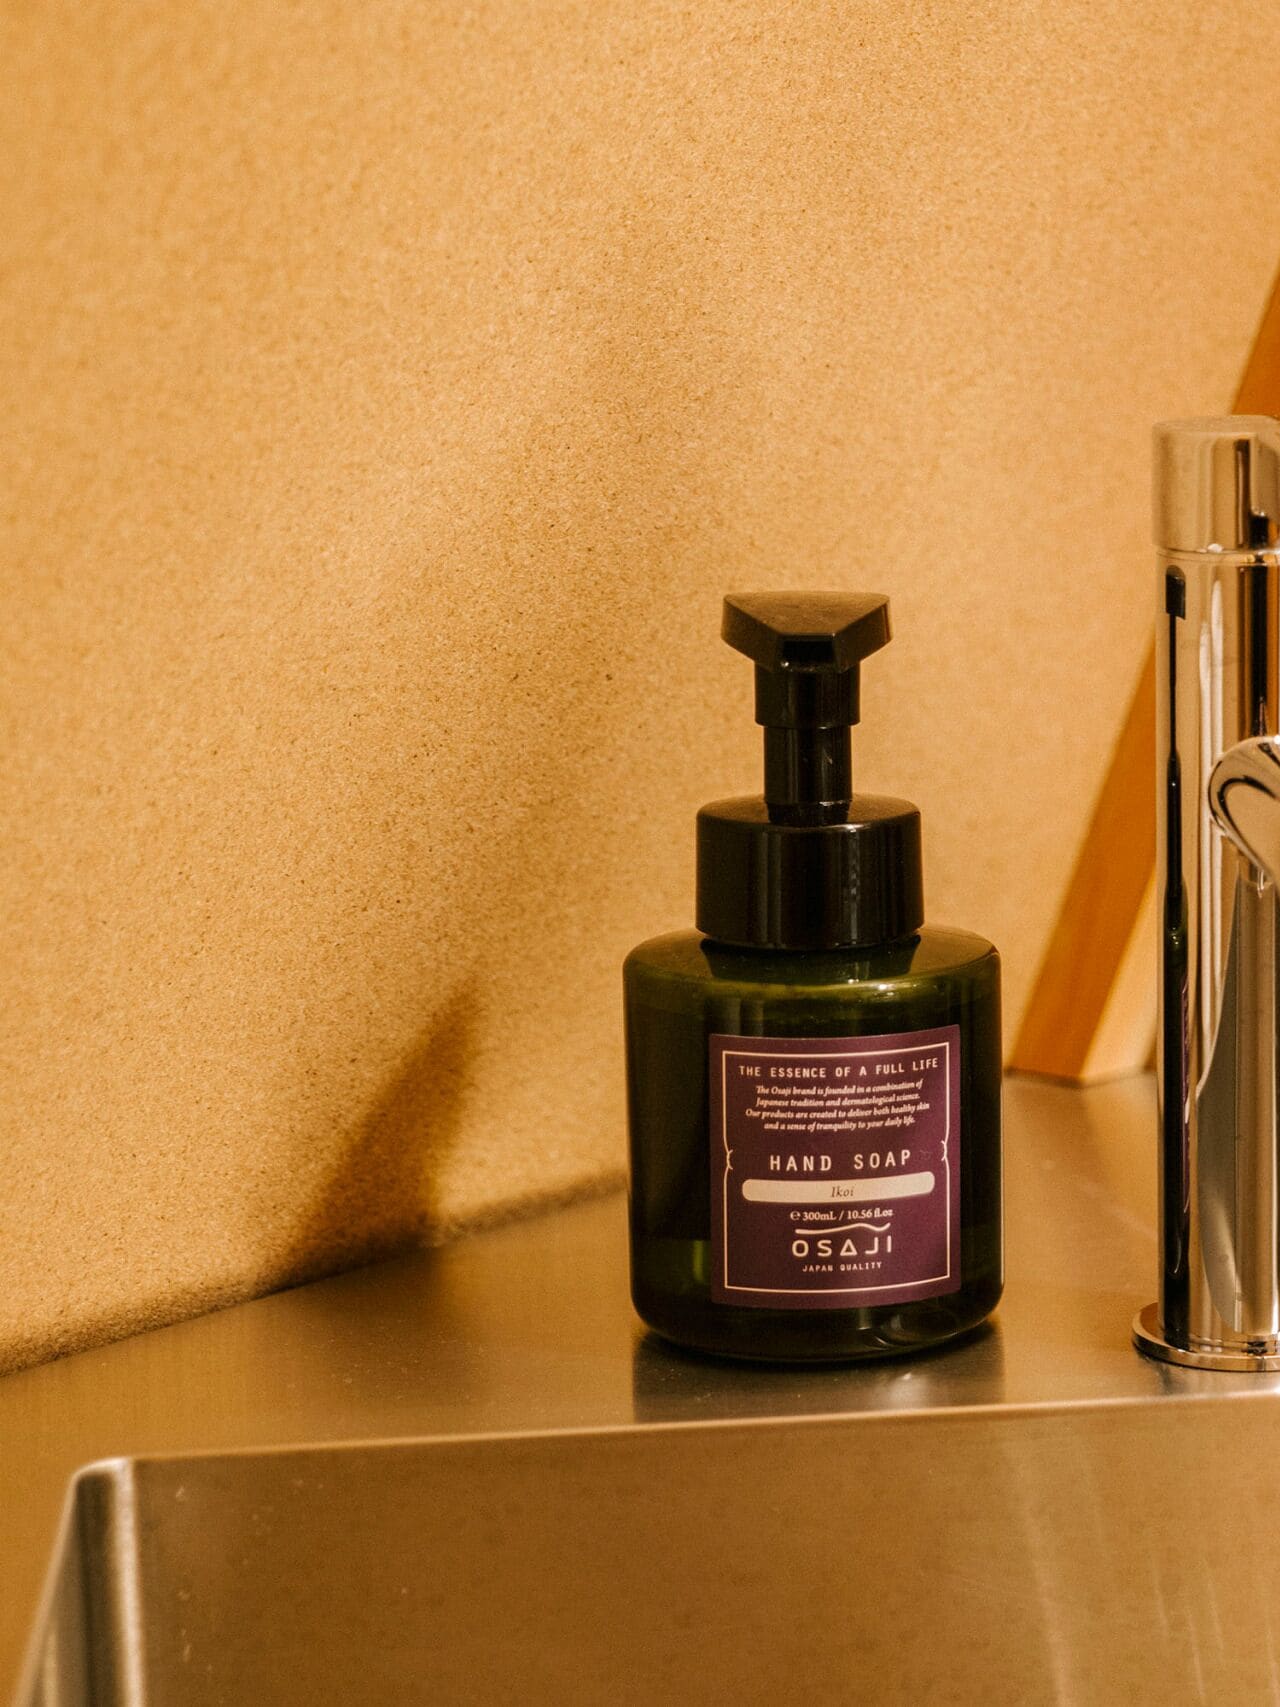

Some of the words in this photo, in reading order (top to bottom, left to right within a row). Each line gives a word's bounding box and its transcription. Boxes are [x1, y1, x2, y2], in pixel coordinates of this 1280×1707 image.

[739, 1065, 761, 1077] THE
[770, 1067, 826, 1078] ESSENCE
[835, 1066, 851, 1077] OF
[859, 1066, 867, 1076] A
[875, 1063, 905, 1075] FULL
[912, 1057, 938, 1071] LIFE
[755, 1085, 769, 1094] The
[771, 1086, 791, 1096] Osaji
[793, 1086, 816, 1095] brand
[817, 1087, 823, 1095] is
[823, 1085, 856, 1097] founded
[872, 1082, 915, 1092] combination
[916, 1078, 924, 1090] of
[755, 1097, 788, 1108] Japanese
[790, 1098, 824, 1106] tradition
[825, 1098, 841, 1106] and
[842, 1093, 896, 1105] dermatological
[745, 1108, 760, 1117] Our
[761, 1109, 794, 1119] products
[809, 1109, 837, 1118] created
[838, 1109, 846, 1117] to
[847, 1108, 872, 1117] deliver
[873, 1107, 890, 1115] both
[891, 1103, 915, 1114] healthy
[916, 1101, 930, 1110] skin
[764, 1121, 779, 1129] and
[807, 1121, 816, 1132] of
[816, 1120, 857, 1131] tranquility
[858, 1121, 866, 1129] to
[866, 1120, 884, 1129] your
[884, 1117, 903, 1127] daily
[769, 1154, 832, 1171] HAND
[853, 1149, 911, 1170] SOAP
[830, 1186, 855, 1198] Ikoi
[802, 1211, 837, 1221] 300mL
[838, 1210, 844, 1220] /
[791, 1235, 892, 1258] OSAJI
[802, 1264, 834, 1273] JAPAN
[840, 1261, 882, 1272] QUALITY
